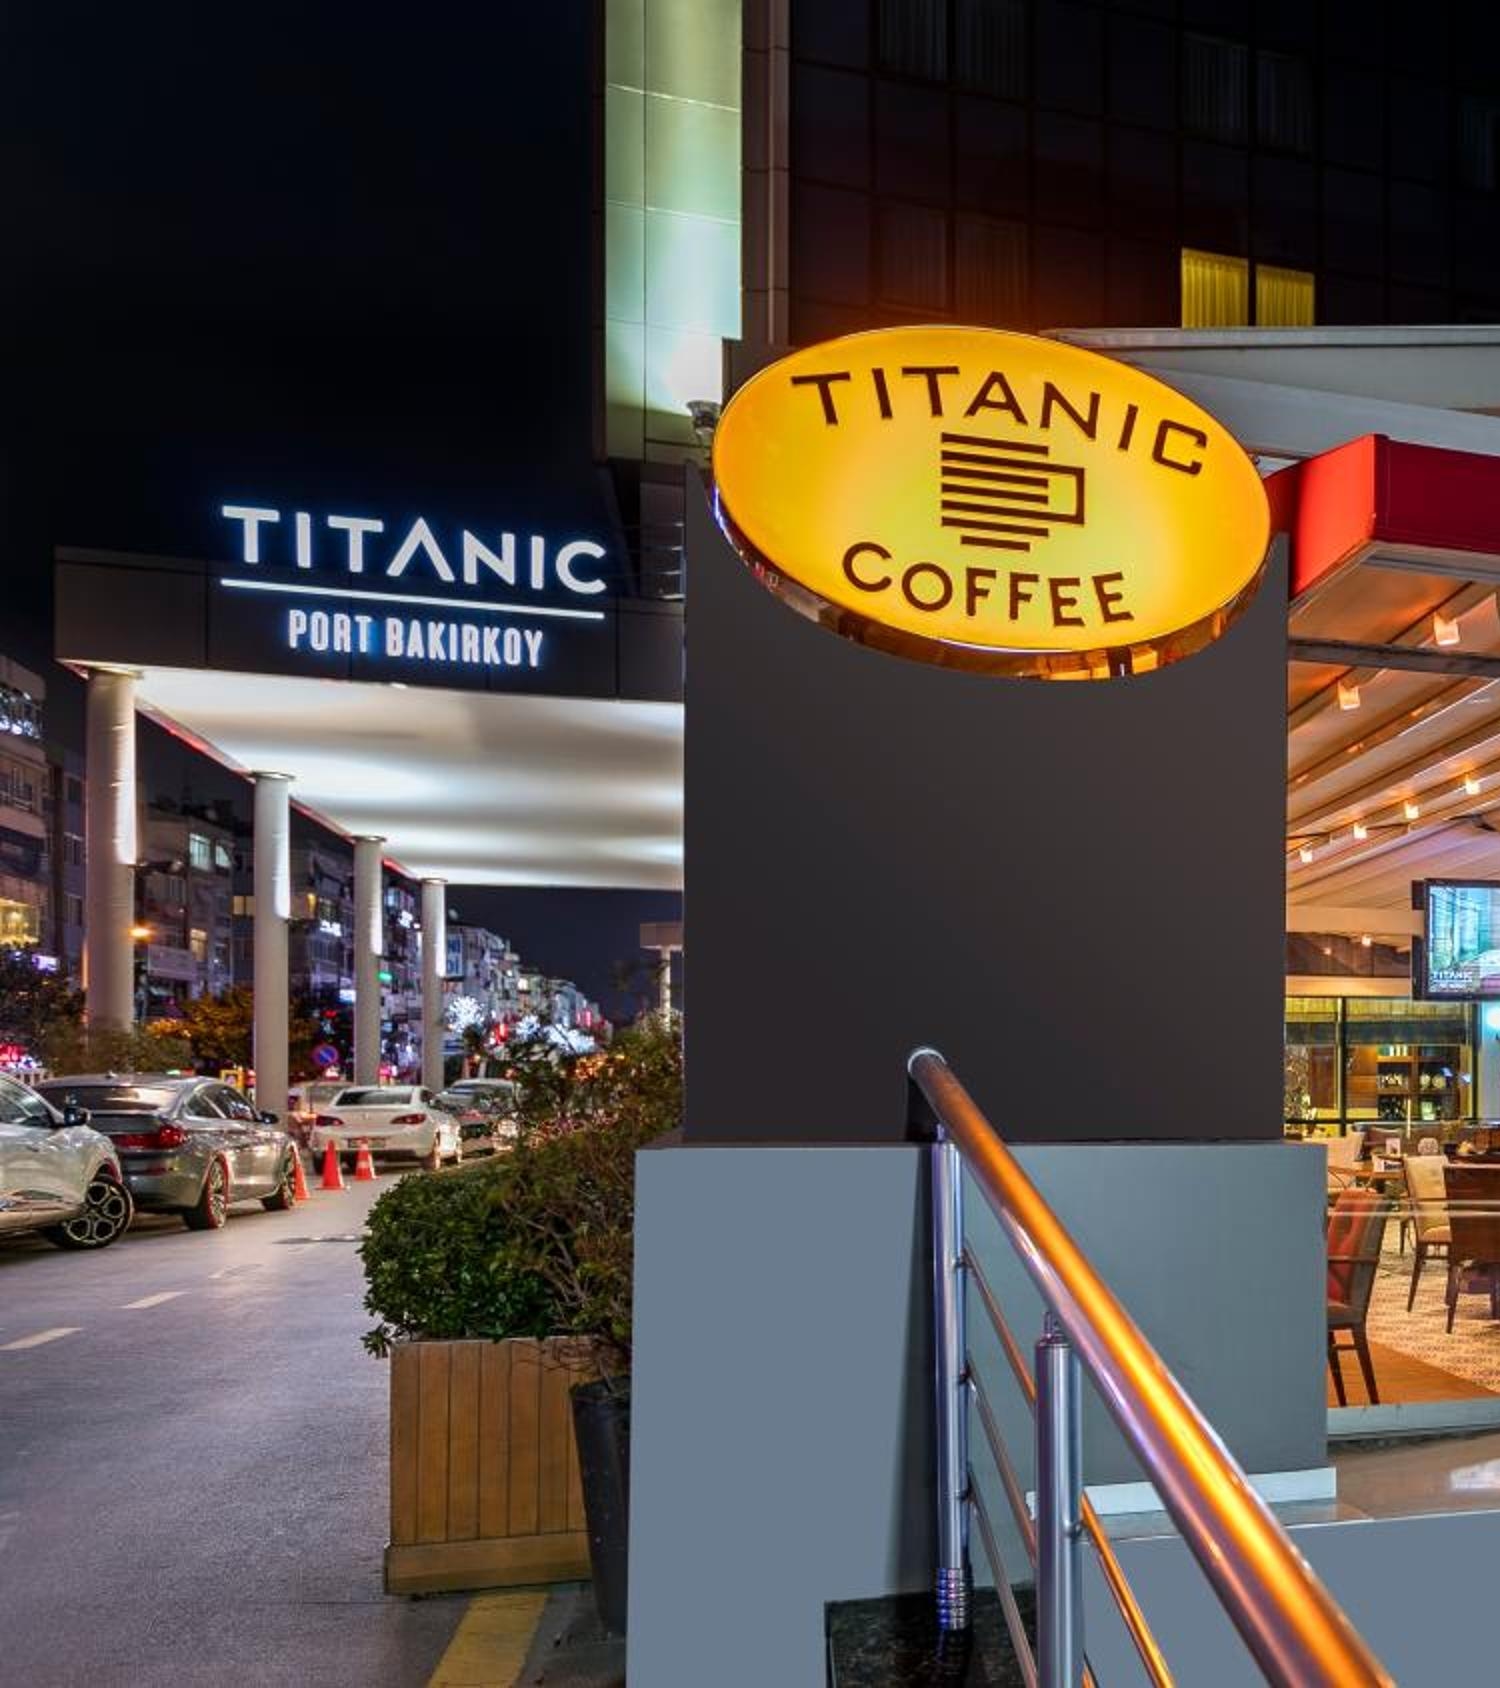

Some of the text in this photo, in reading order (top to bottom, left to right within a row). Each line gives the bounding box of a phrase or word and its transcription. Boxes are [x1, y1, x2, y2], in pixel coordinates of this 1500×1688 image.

[791, 365, 1208, 477] TITANIC
[221, 505, 607, 594] TITANIC
[842, 541, 1134, 627] COFFEE
[288, 609, 544, 667] PORT BAKIRKOY
